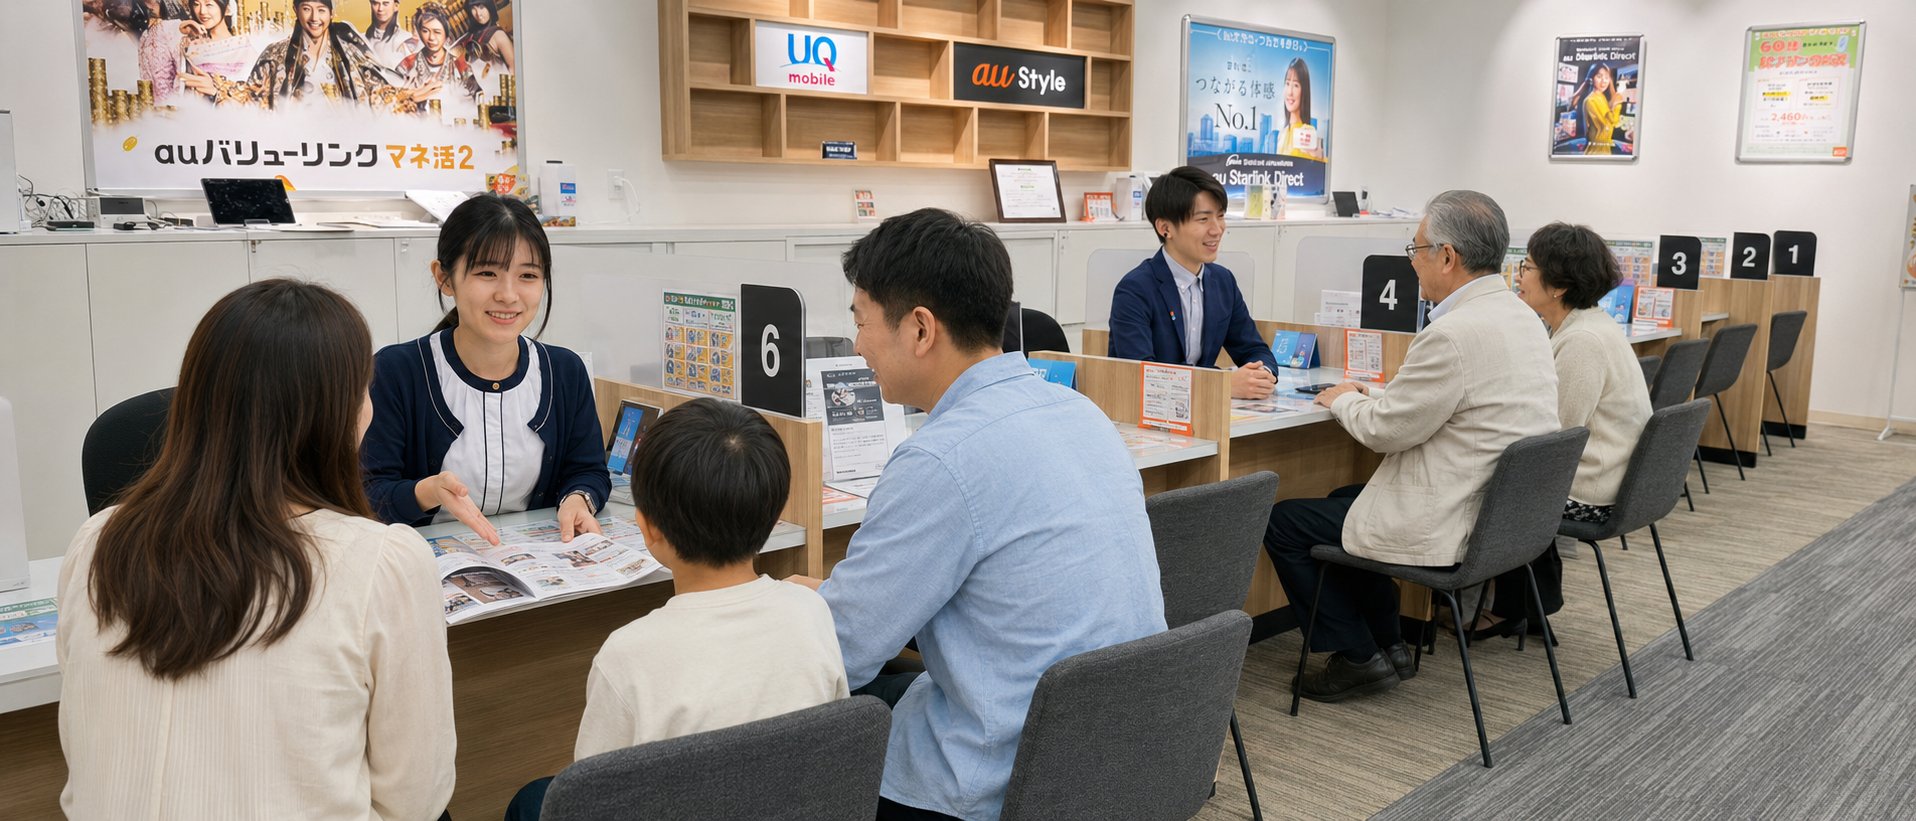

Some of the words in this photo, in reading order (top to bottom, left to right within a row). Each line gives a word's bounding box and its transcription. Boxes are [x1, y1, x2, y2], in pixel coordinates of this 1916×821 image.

[788, 33, 837, 72] UQ
[788, 72, 835, 86] mobile
[971, 63, 1015, 88] au
[1018, 65, 1066, 95] Style
[1195, 76, 1275, 100] つながる体感
[1214, 102, 1258, 131] No.1
[385, 143, 475, 170] マネ活2
[1274, 170, 1304, 187] Direct
[1671, 251, 1687, 275] 3
[1742, 246, 1757, 267] 2
[1788, 244, 1799, 264] 1
[1379, 279, 1398, 310] 4
[761, 323, 780, 378] 6
